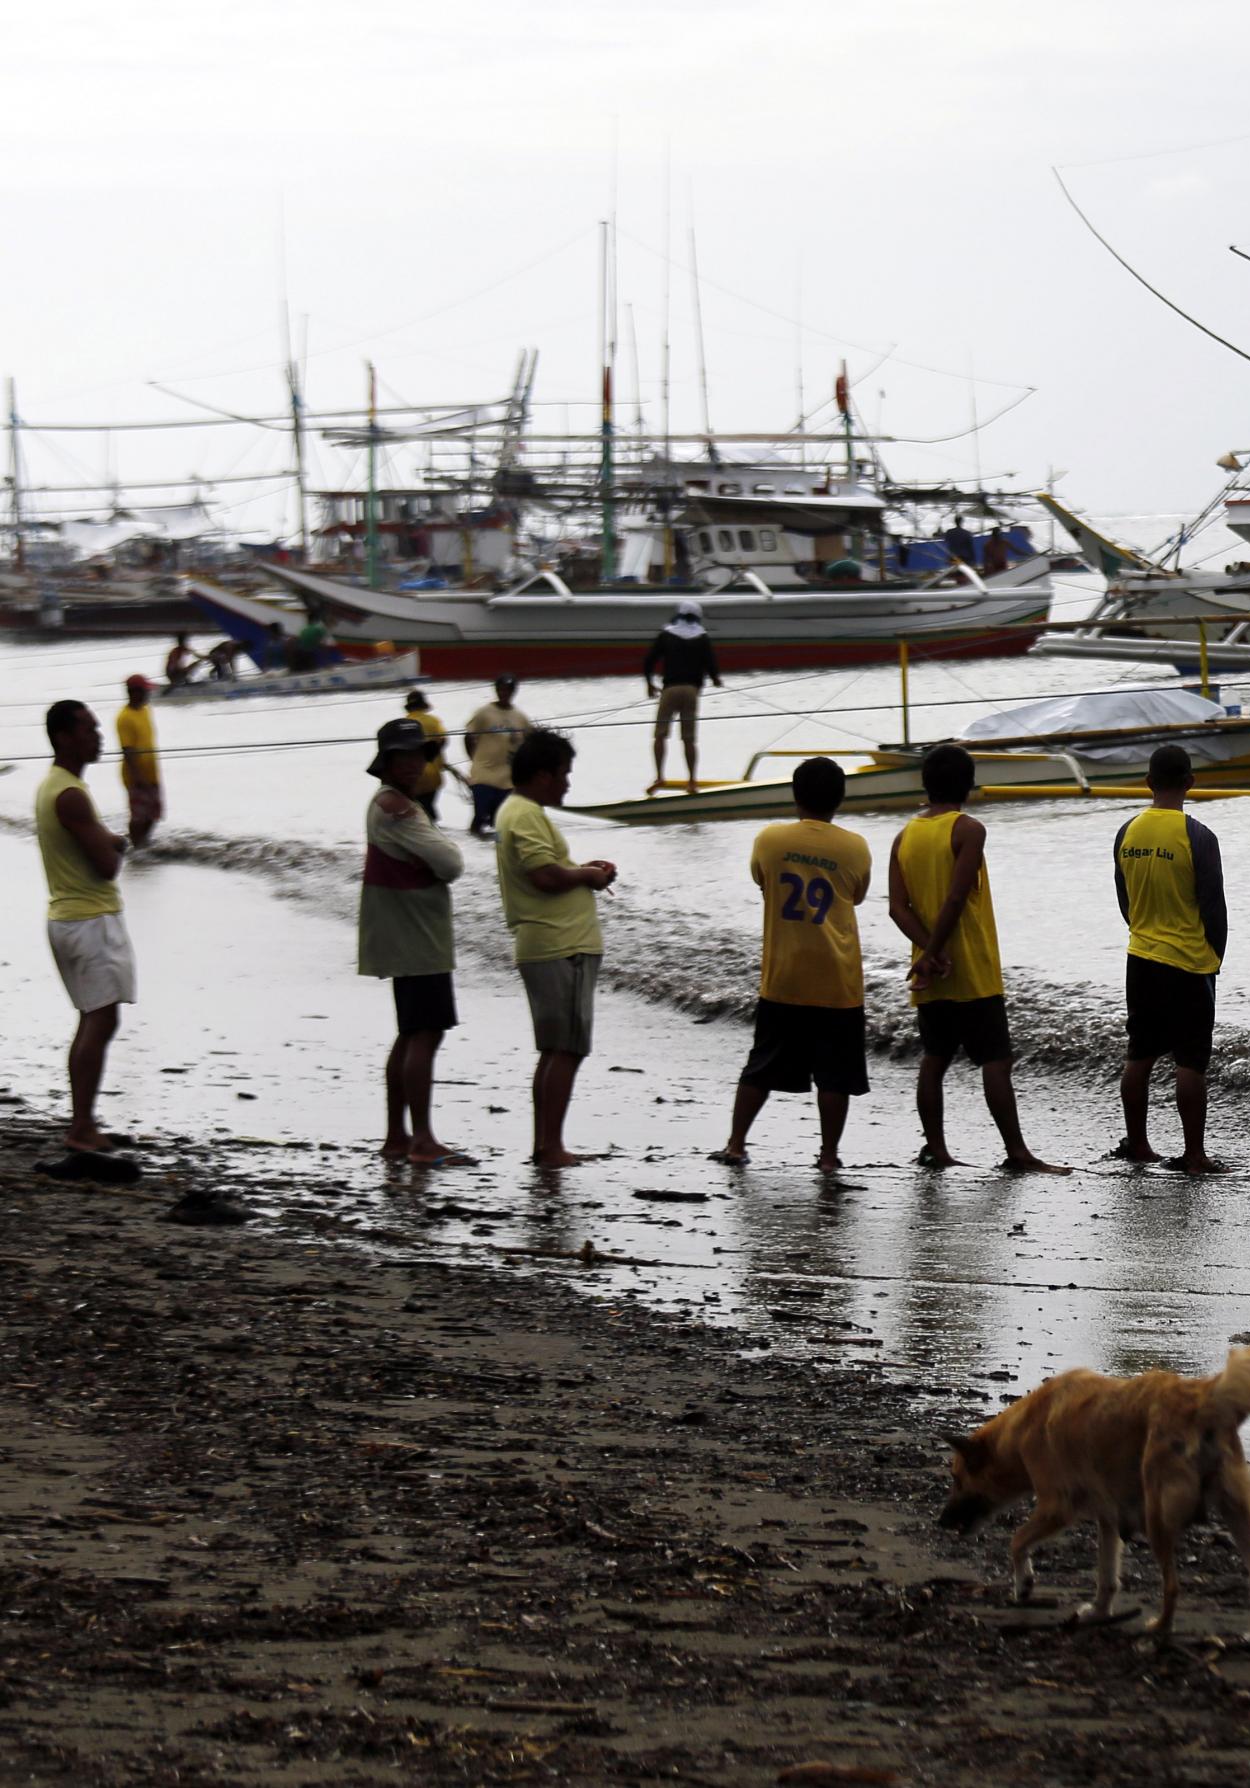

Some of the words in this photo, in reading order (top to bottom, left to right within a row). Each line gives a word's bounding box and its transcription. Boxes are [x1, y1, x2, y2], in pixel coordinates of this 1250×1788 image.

[783, 852, 838, 871] JONARD
[1122, 847, 1153, 859] Edgar
[1156, 847, 1175, 861] Liu
[780, 873, 833, 925] 29
